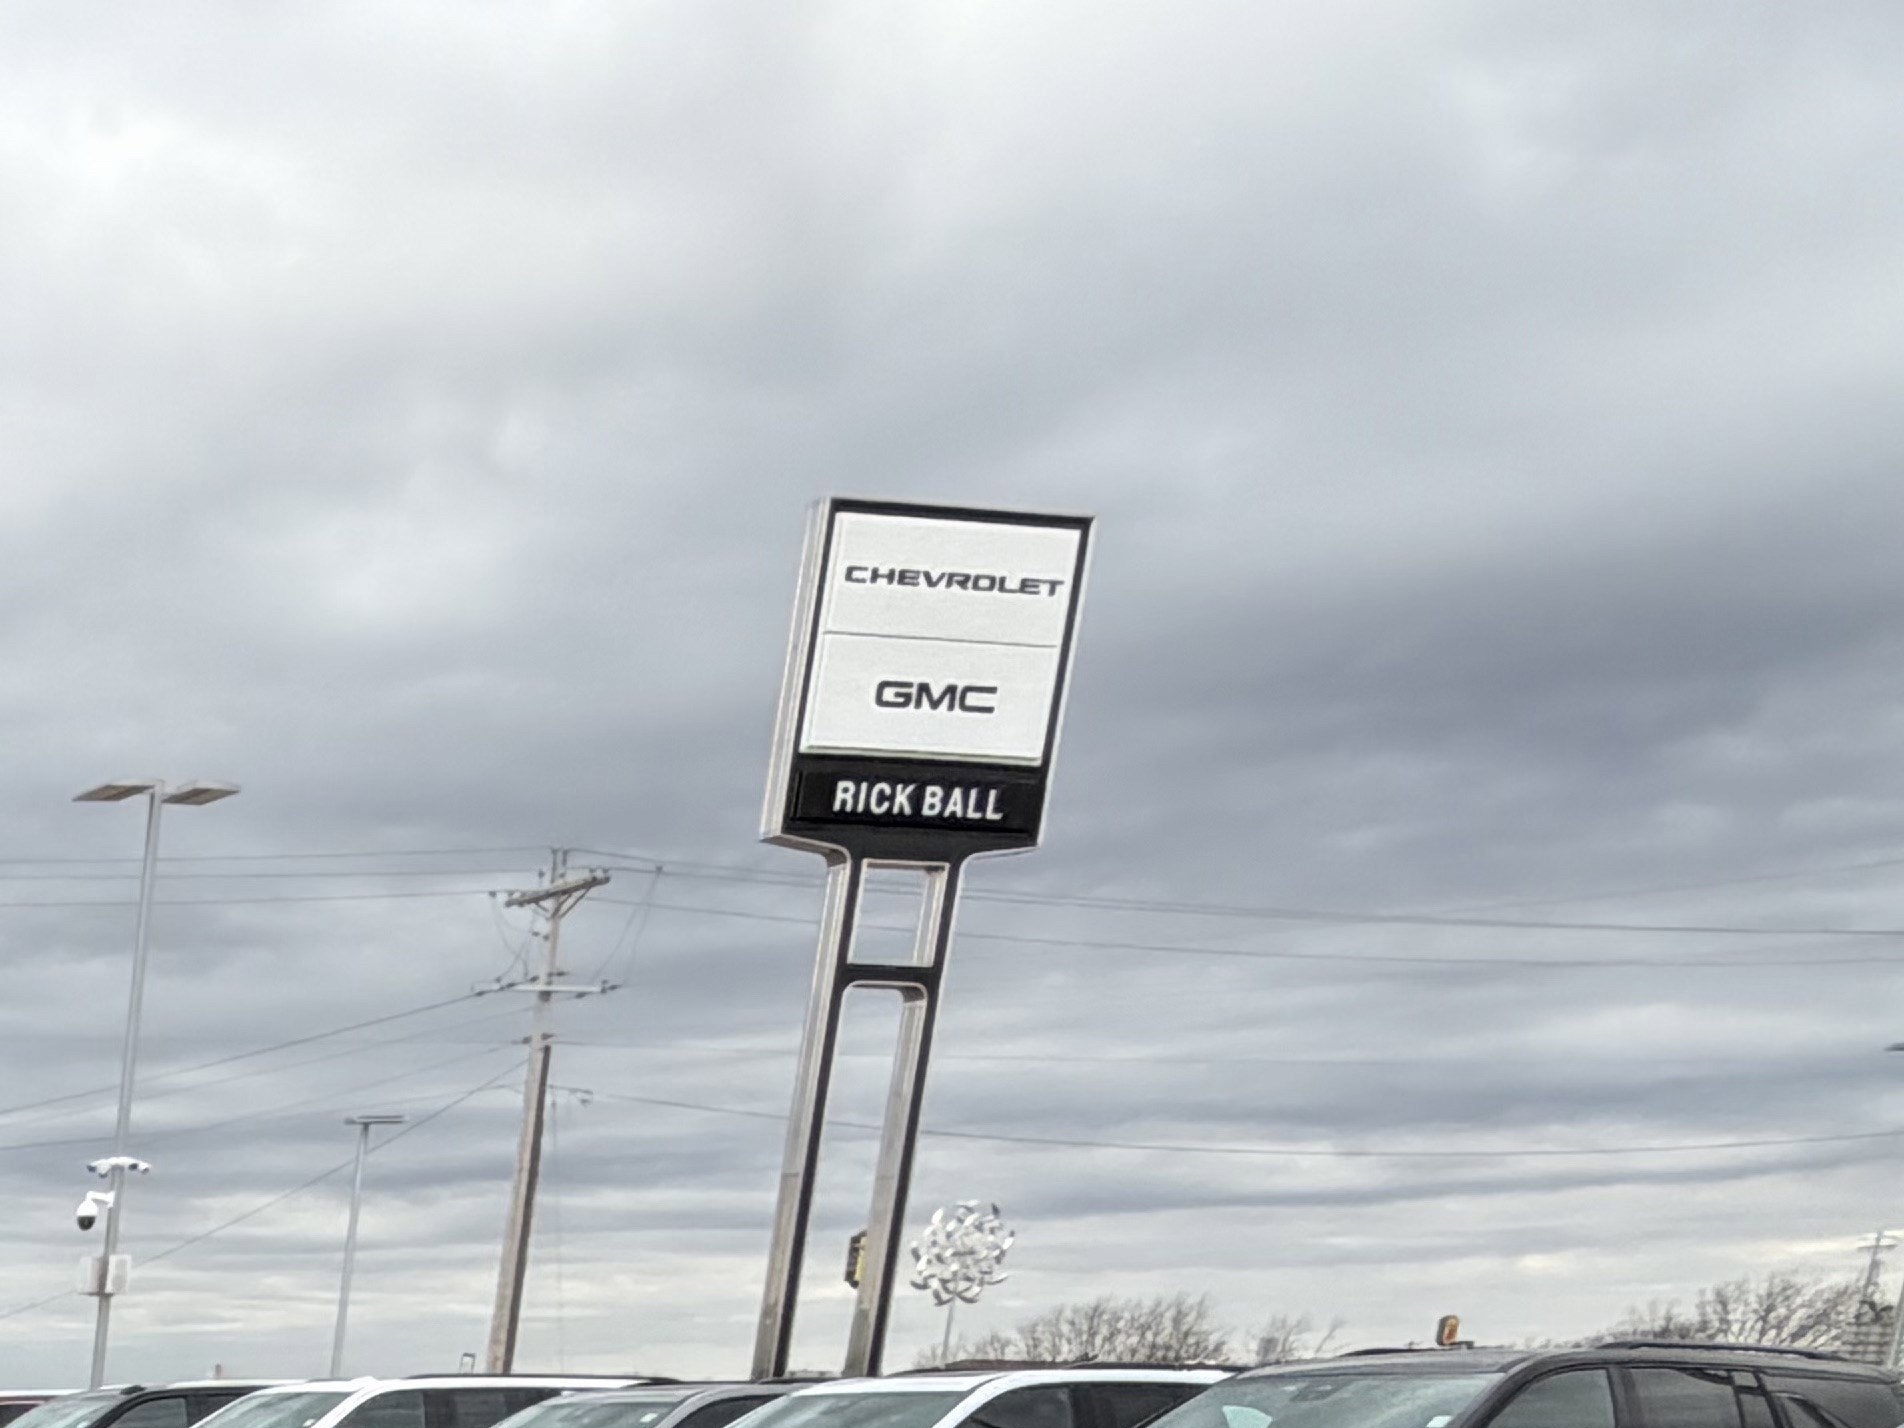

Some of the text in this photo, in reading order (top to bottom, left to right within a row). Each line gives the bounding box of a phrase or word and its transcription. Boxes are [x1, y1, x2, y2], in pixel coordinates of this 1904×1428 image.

[844, 565, 1064, 597] CHEVROLET
[874, 680, 998, 714] GMC
[832, 779, 1004, 821] RICK BALL
